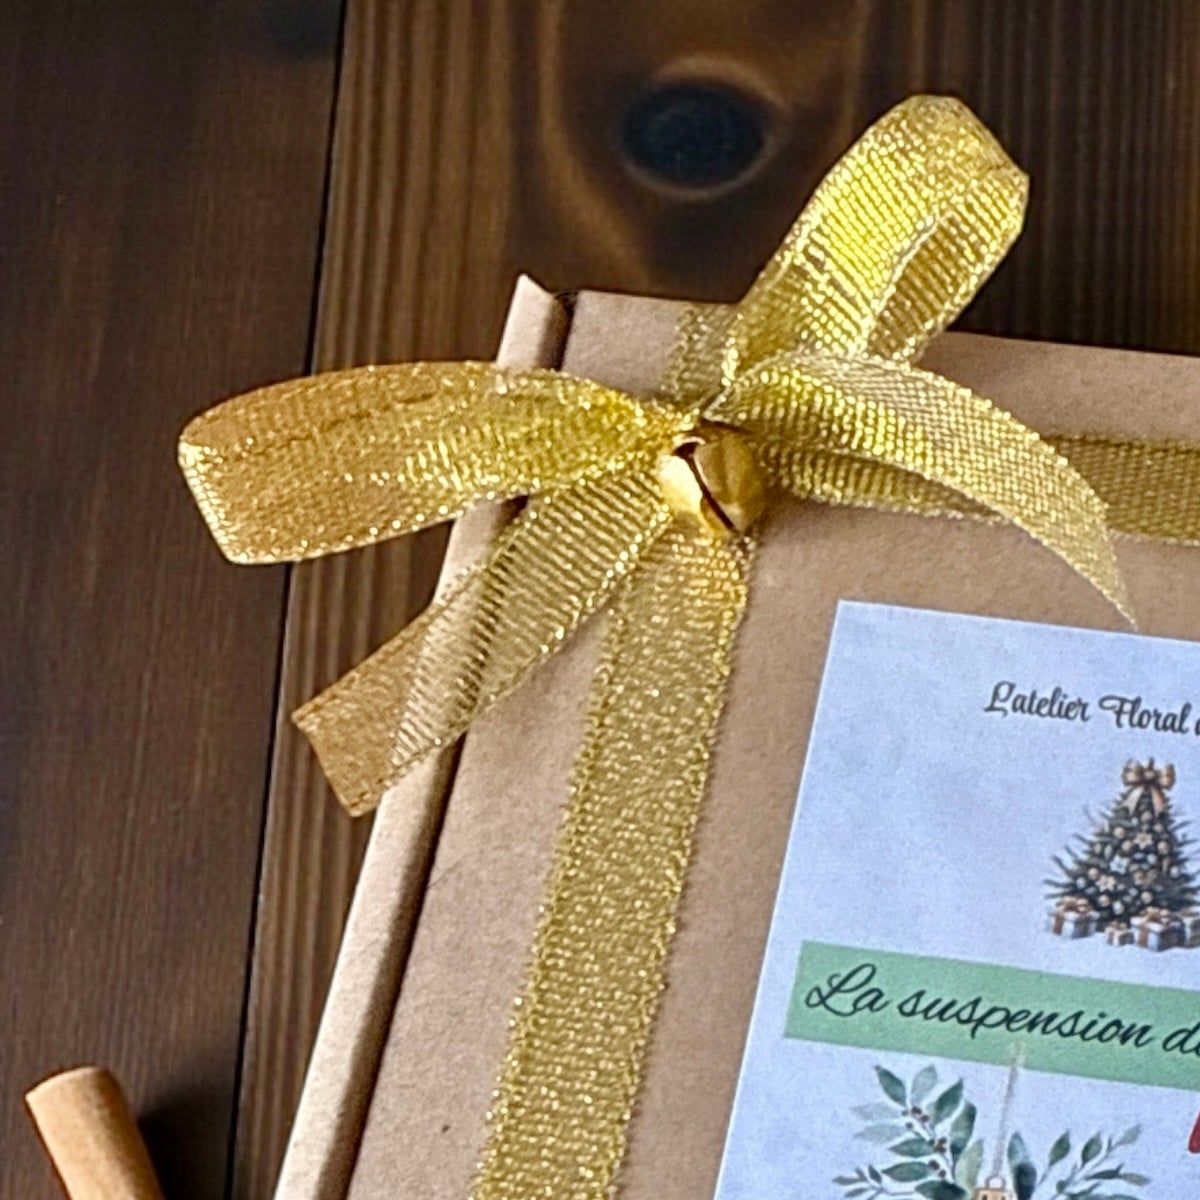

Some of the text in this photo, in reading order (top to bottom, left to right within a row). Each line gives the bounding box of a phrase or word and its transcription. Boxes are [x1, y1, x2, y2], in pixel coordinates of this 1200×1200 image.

[1098, 695, 1191, 734] Floral
[805, 963, 889, 1018] La
[897, 988, 1151, 1049] suspension
